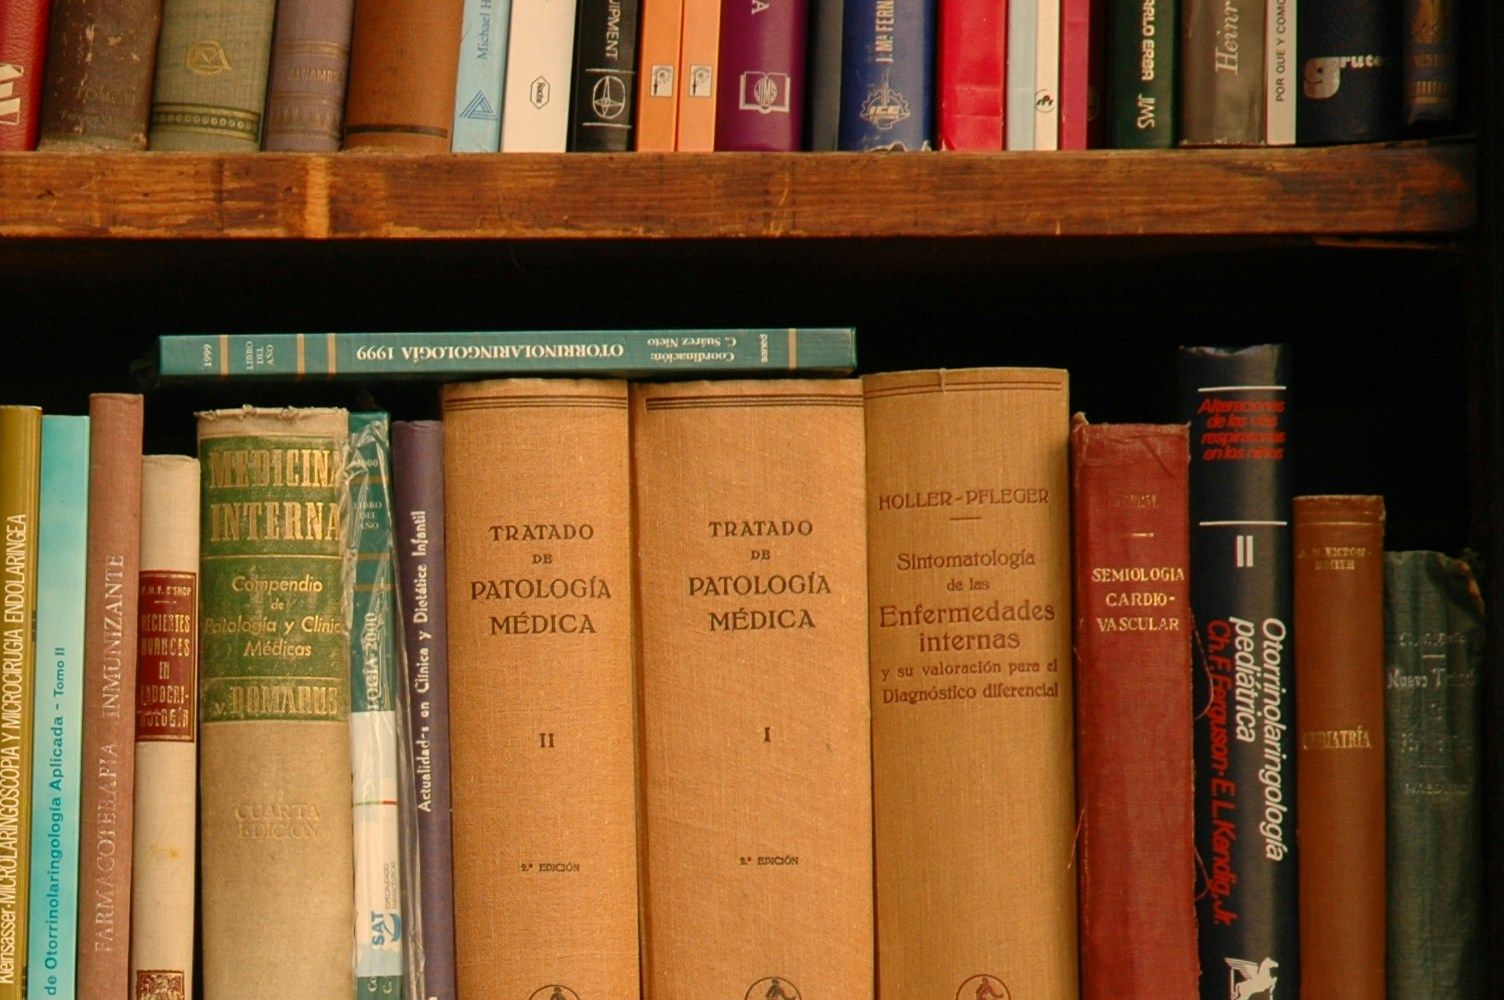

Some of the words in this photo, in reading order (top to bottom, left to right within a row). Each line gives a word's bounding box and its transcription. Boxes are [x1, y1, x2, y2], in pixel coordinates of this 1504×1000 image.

[477, 11, 492, 61] Michael
[1276, 81, 1284, 102] POR
[400, 342, 625, 361] OTORRINOLARINGOLOGÍA
[878, 488, 1050, 512] HOLLER-PFLEGER
[411, 510, 428, 557] Infantil
[488, 523, 595, 542] TRATADO
[708, 519, 814, 538] TRATADO
[4, 514, 26, 623] ENDOLARINGEA
[1092, 567, 1185, 583] SEMIOLOGIA
[414, 564, 429, 623] Dietética
[470, 575, 612, 601] PATOLOGÍA
[688, 570, 832, 597] PATOLOGÍA
[488, 610, 596, 636] MÉDICA
[708, 606, 816, 632] MÉDICA
[879, 598, 1056, 628] Enfermedades
[1097, 617, 1180, 632] VASCULAR
[101, 554, 124, 719] INMUNIZANTE
[918, 628, 1021, 652] internas
[53, 656, 65, 697] Tomo
[920, 658, 1002, 676] valoración
[1008, 660, 1041, 676] para
[1230, 616, 1257, 744] pediátrica
[882, 681, 977, 704] Diagnóstico
[982, 680, 1060, 700] diferencial
[52, 713, 65, 790] Aplicada
[1260, 618, 1289, 863] Otorrinolaringología
[45, 794, 65, 967] Otorrinolaringología
